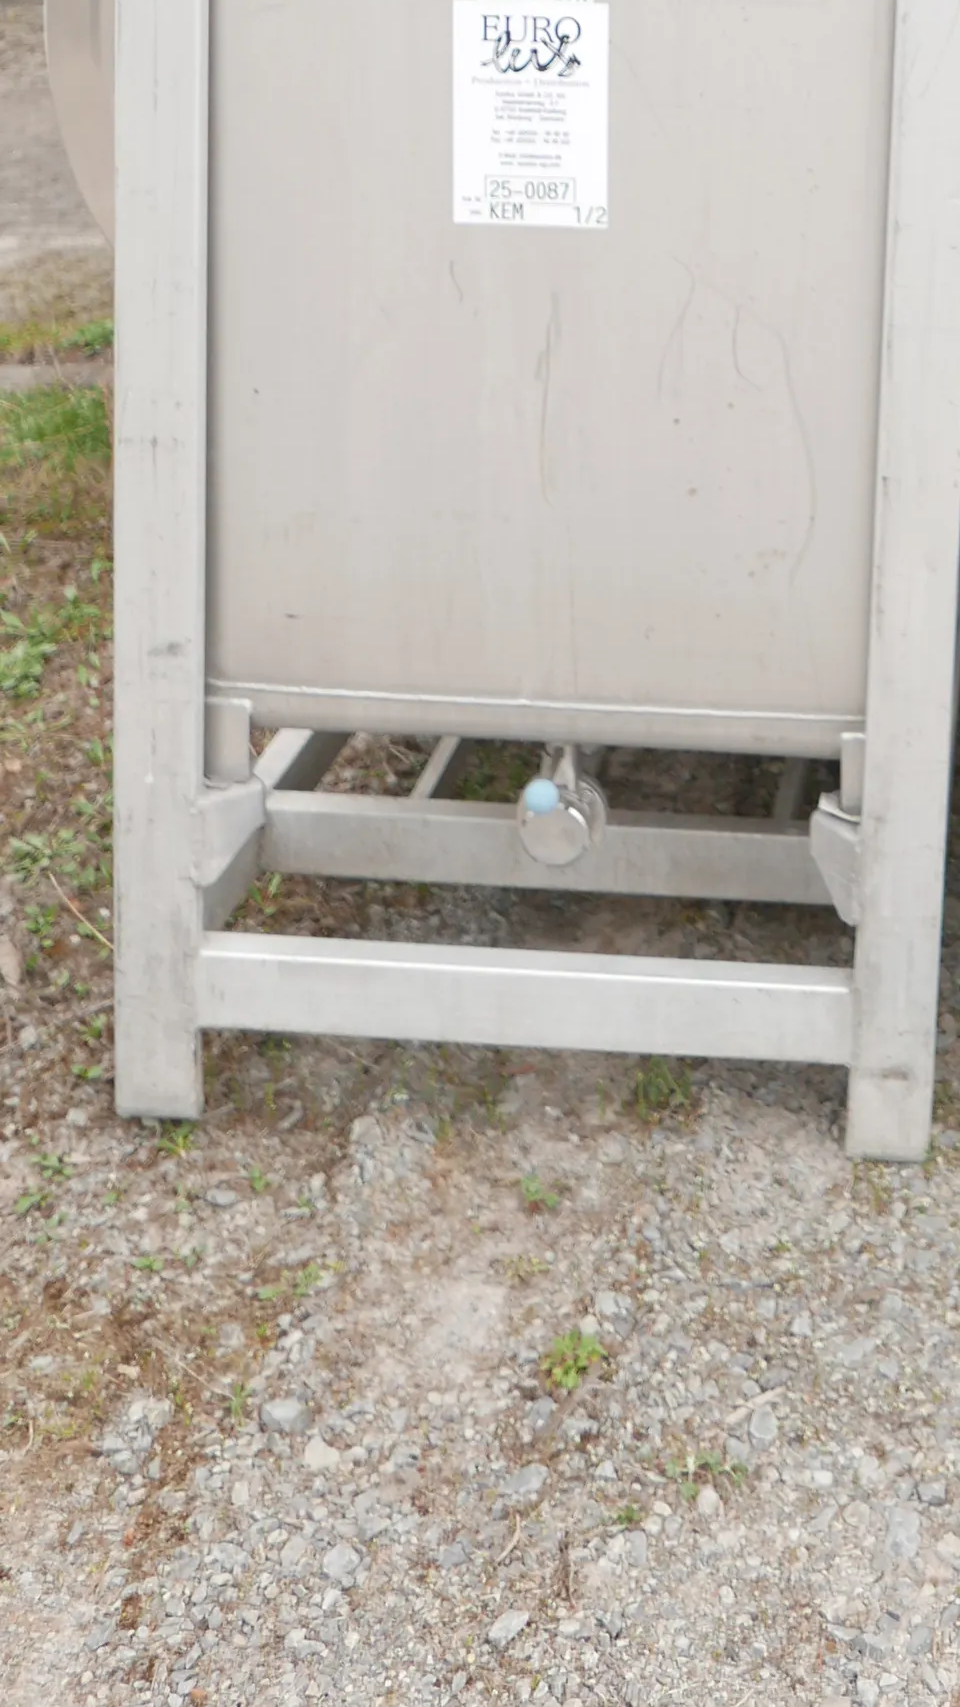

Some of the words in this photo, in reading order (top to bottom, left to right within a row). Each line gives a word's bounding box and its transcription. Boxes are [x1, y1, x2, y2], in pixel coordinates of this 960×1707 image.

[481, 14, 582, 44] EURO
[489, 180, 570, 201] 25-0087
[489, 202, 524, 221] KEM
[572, 205, 608, 225] 1/2
